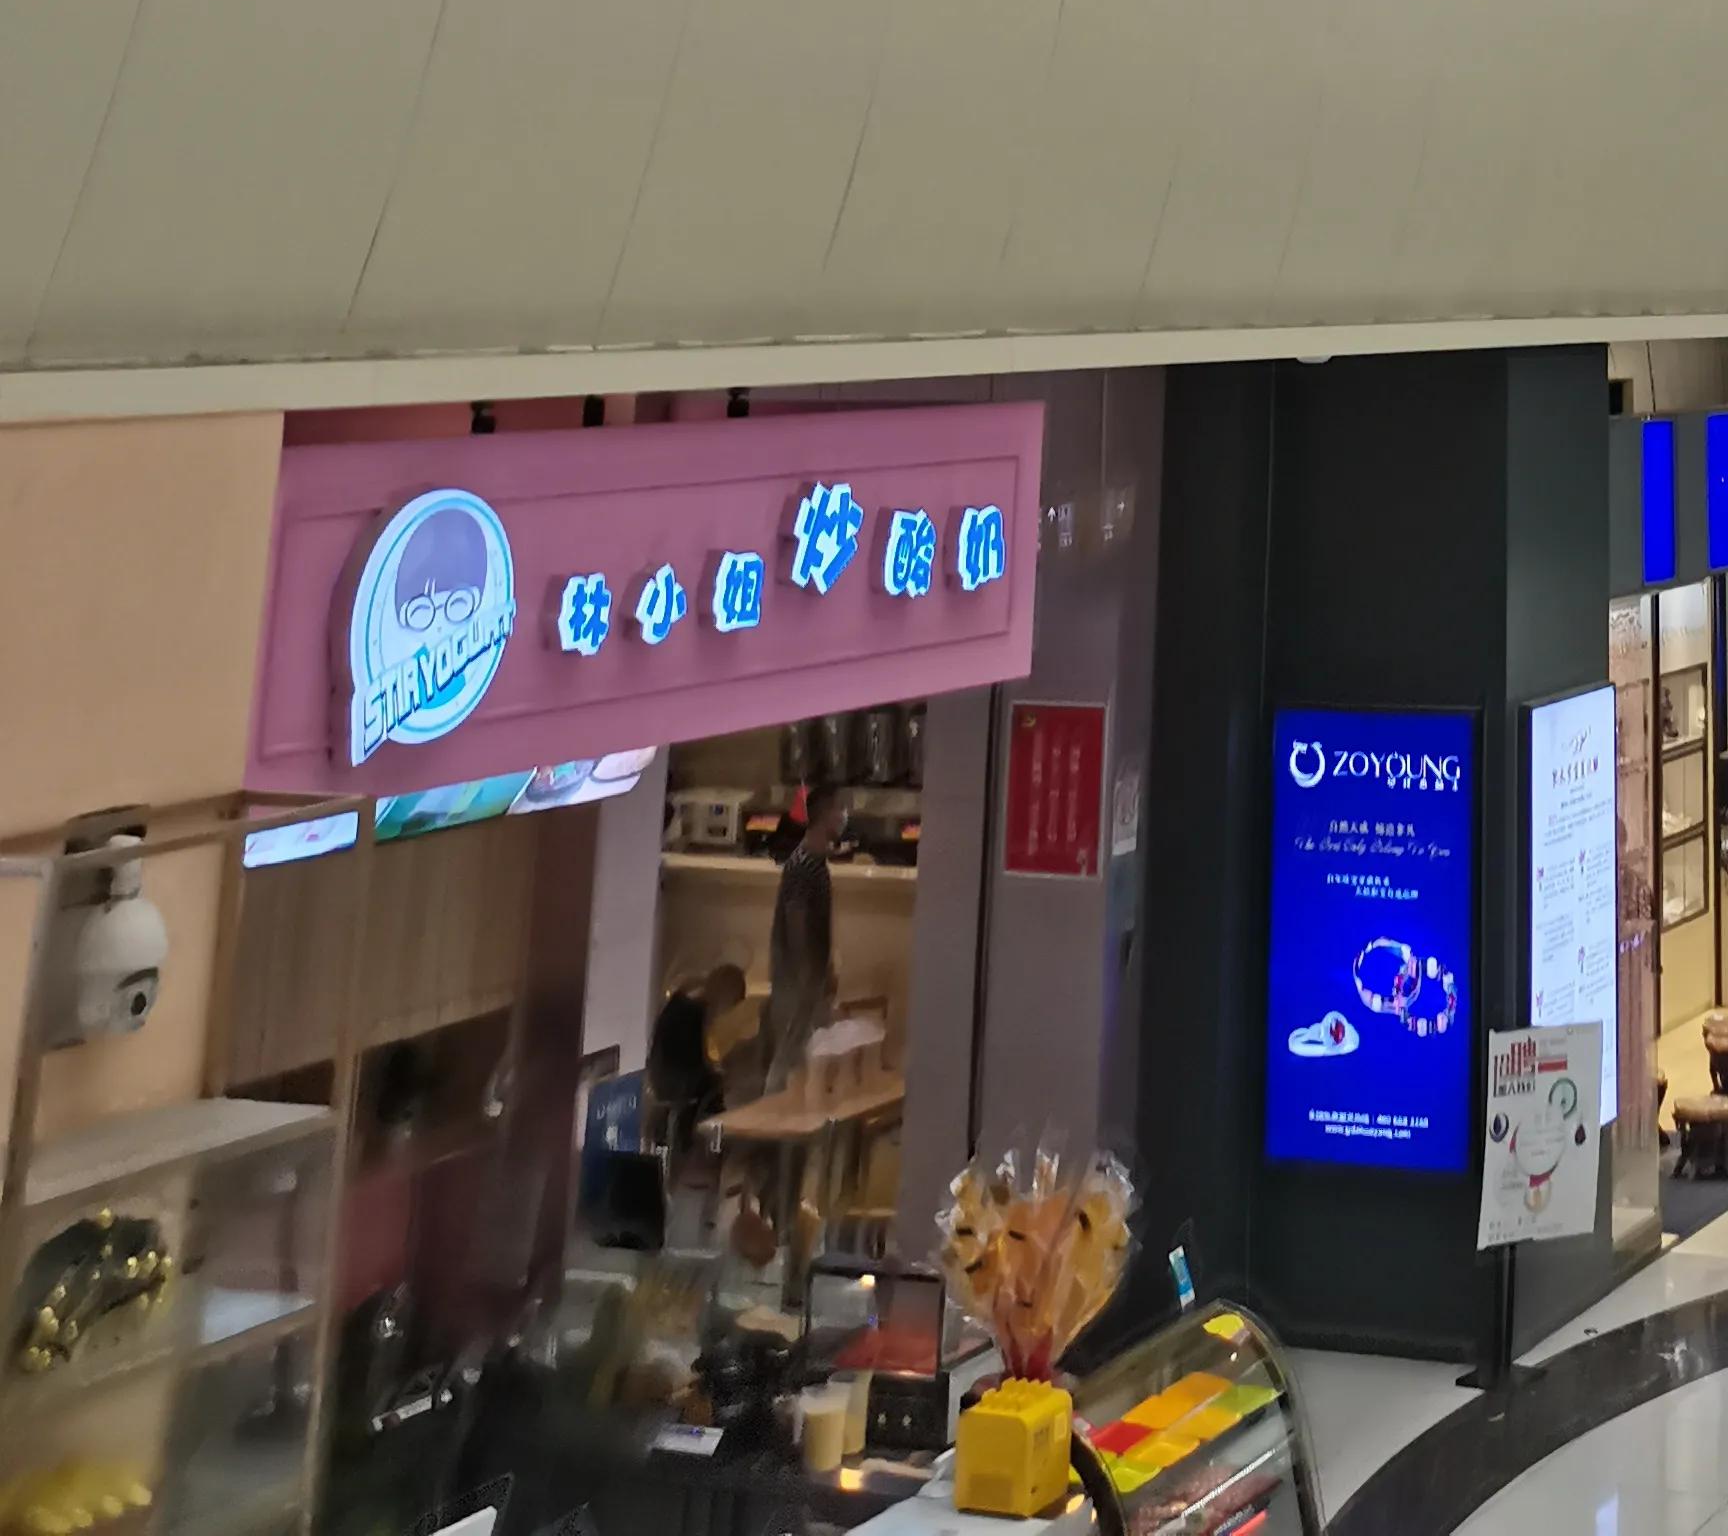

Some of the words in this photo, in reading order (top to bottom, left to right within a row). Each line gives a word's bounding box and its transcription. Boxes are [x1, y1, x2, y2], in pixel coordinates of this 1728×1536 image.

[559, 481, 1006, 656] 林小姐炒酸奶
[1333, 751, 1461, 782] ZOYOUNG
